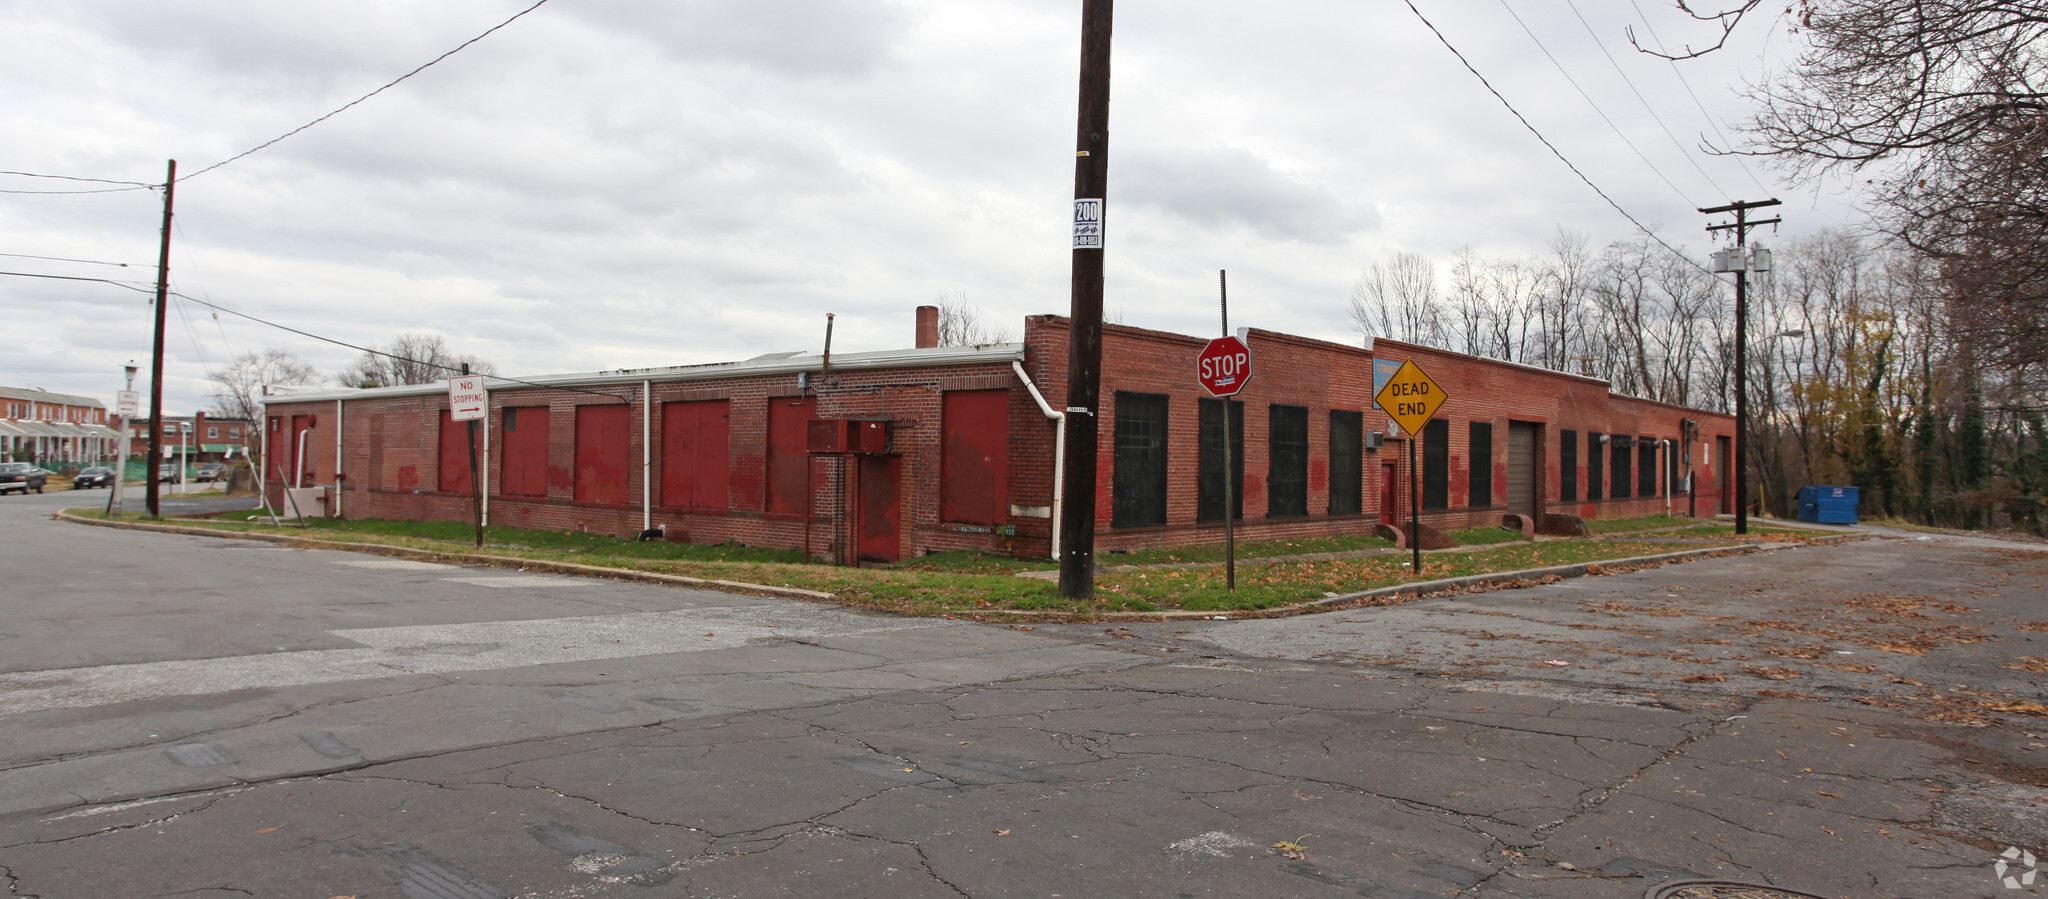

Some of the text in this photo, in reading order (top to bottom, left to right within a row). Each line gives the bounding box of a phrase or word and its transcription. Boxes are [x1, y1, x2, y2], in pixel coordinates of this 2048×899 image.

[1202, 353, 1247, 379] STOP
[460, 381, 473, 390] NO
[1392, 381, 1429, 396] DEAD
[453, 393, 483, 404] STOPPING
[1398, 402, 1426, 416] END
